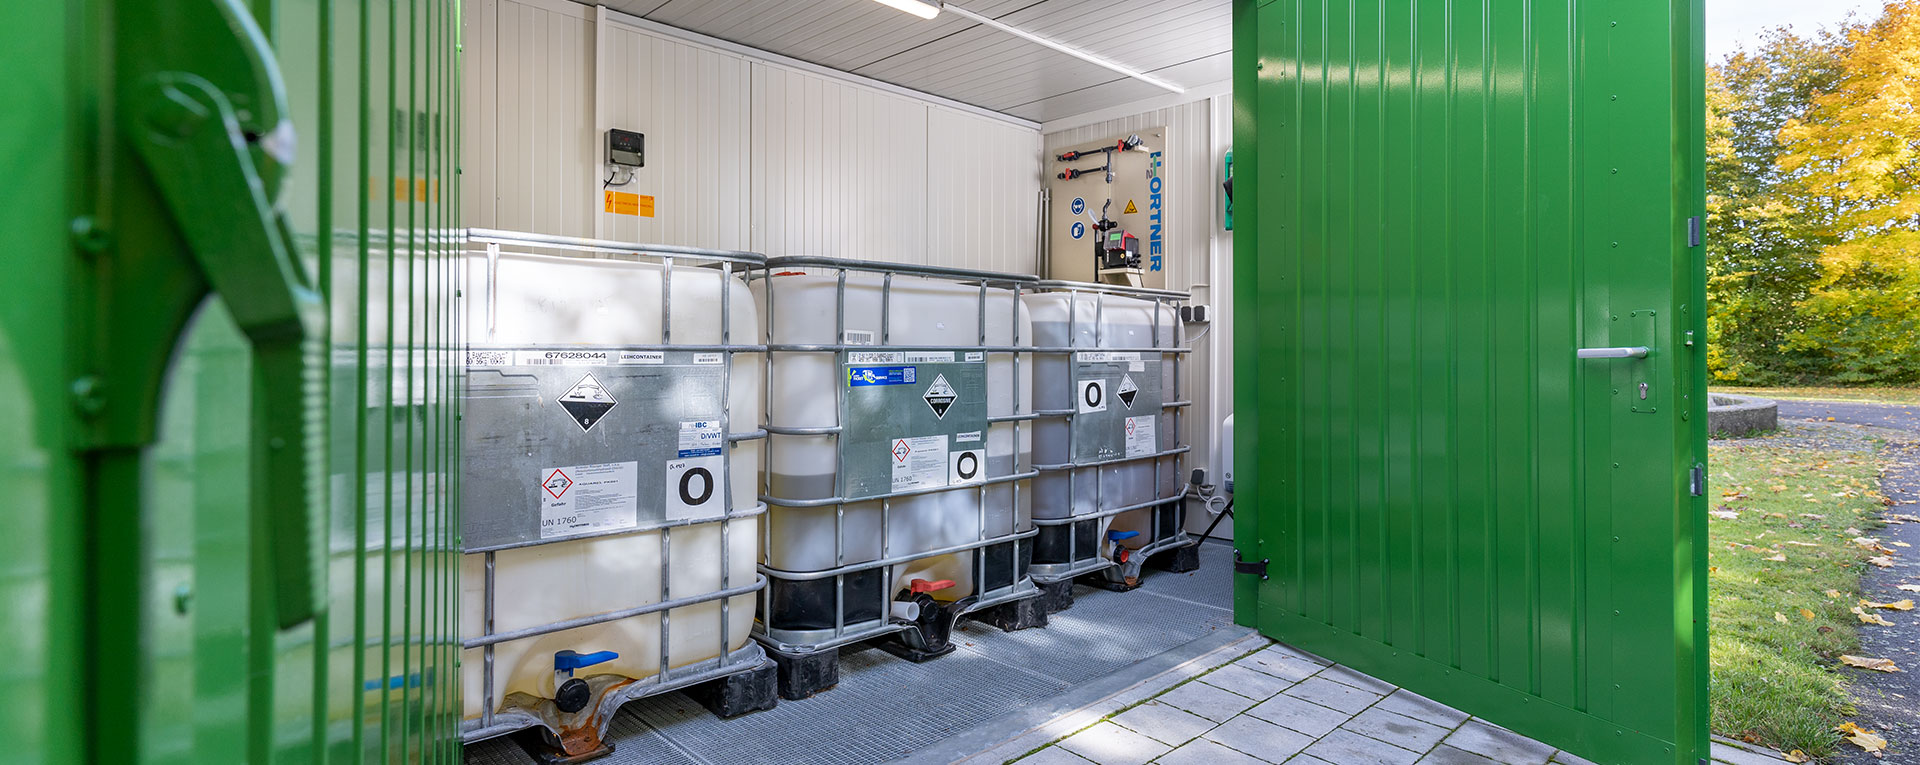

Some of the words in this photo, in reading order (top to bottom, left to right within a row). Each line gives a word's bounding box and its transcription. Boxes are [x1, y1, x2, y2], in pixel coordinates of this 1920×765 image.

[545, 351, 607, 360] 67628044
[695, 421, 707, 429] IBC
[542, 519, 554, 527] UN
[557, 515, 577, 526] 1760
